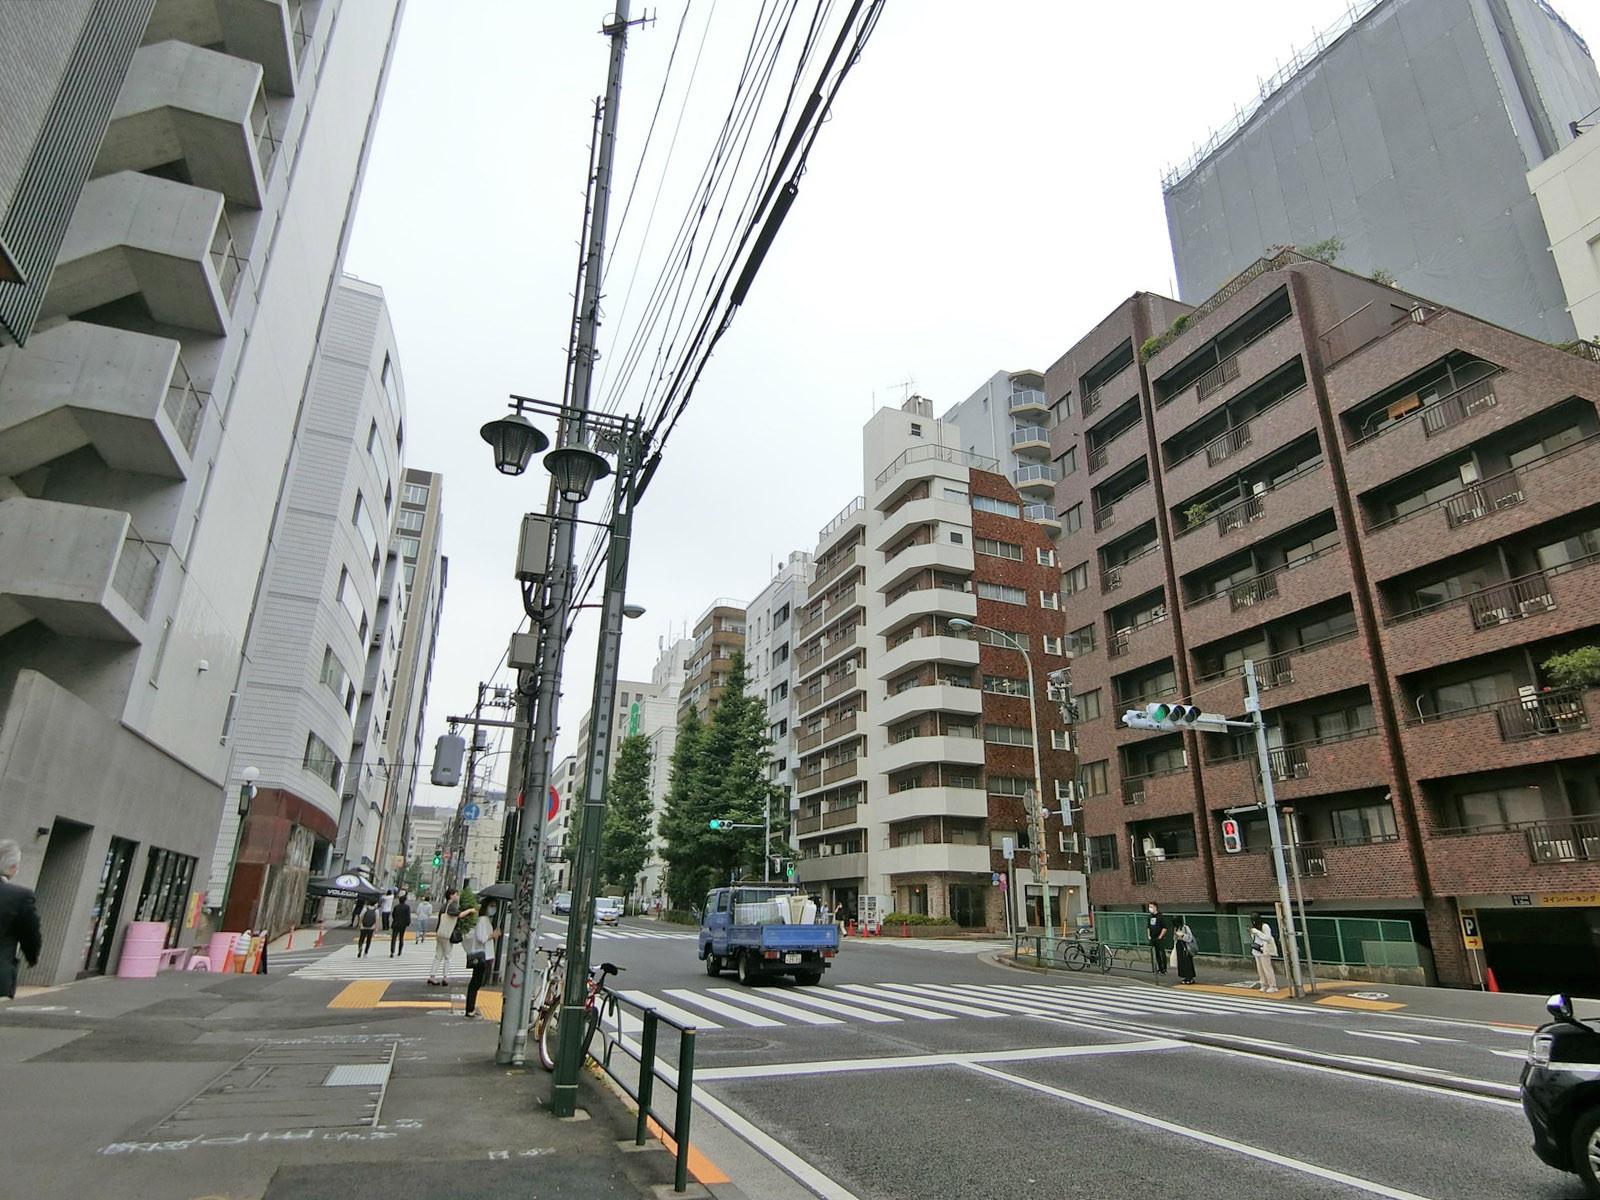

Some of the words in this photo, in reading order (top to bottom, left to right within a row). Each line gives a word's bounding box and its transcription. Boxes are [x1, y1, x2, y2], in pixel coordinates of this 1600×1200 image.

[327, 889, 359, 897] VOLCOM
[1543, 895, 1596, 903] コインパーキング
[1464, 918, 1474, 935] P
